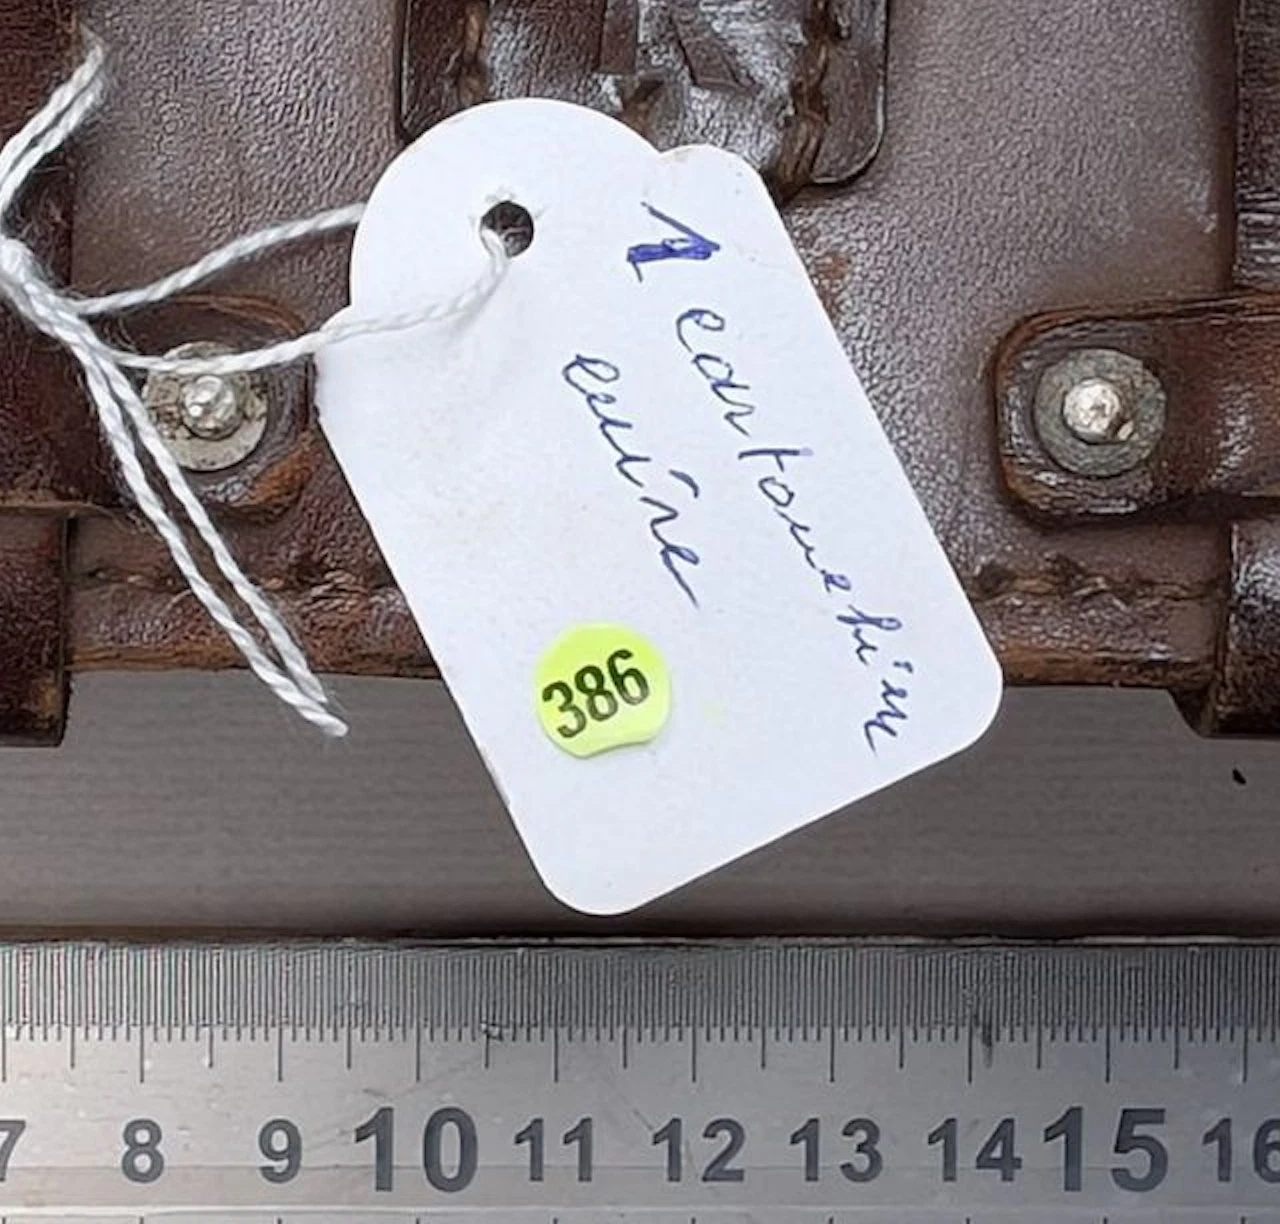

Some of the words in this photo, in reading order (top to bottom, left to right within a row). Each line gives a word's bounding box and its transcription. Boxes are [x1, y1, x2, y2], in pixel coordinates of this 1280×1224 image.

[542, 649, 649, 738] 386
[122, 1119, 164, 1184] 8
[259, 1119, 302, 1184] 9
[355, 1107, 478, 1193] 10
[514, 1117, 592, 1182] 11
[652, 1118, 745, 1182] 12
[790, 1118, 882, 1182] 13
[928, 1118, 1022, 1182] 14
[1044, 1106, 1168, 1192] 15
